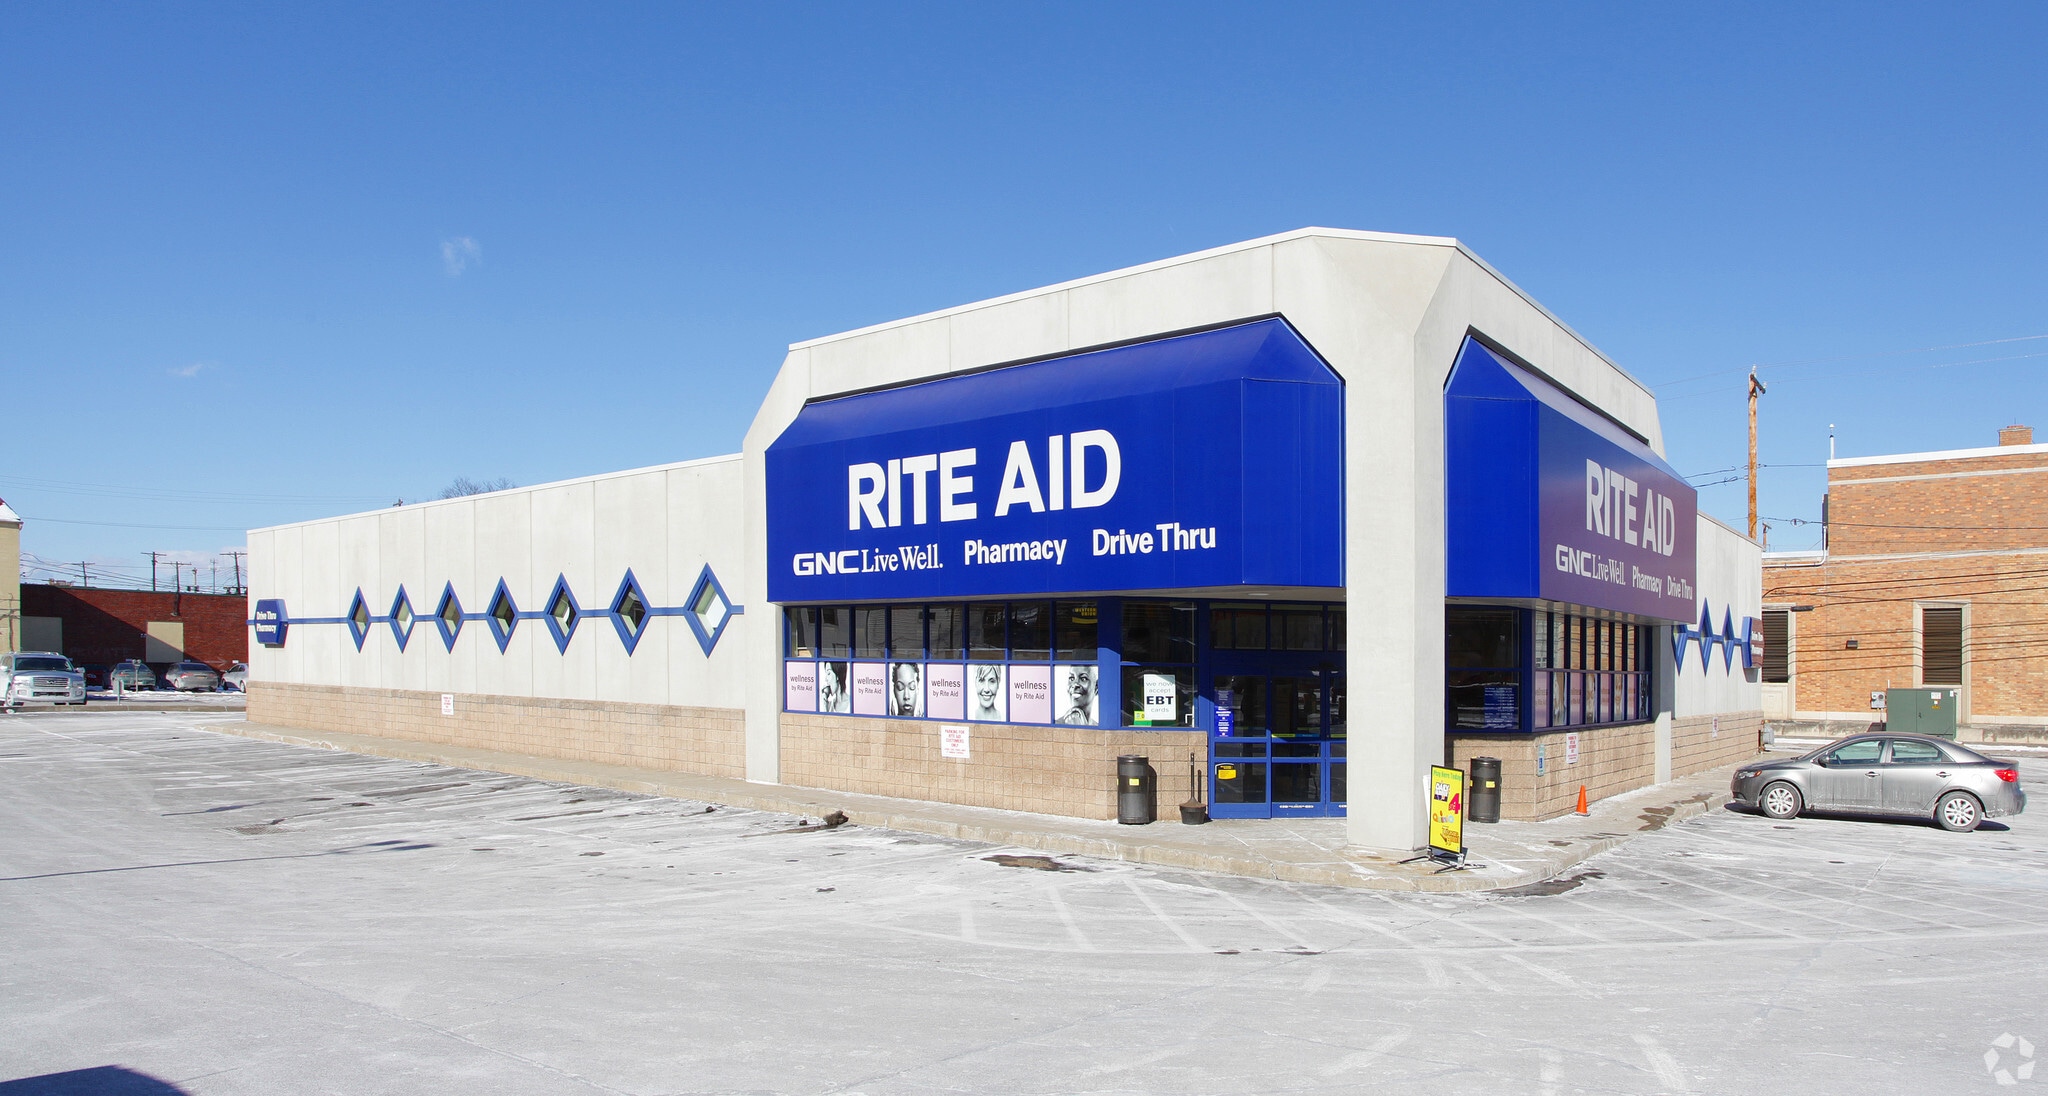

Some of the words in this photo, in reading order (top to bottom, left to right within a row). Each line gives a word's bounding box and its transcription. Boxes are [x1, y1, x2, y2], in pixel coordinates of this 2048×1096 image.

[848, 448, 977, 531] RITE
[995, 429, 1121, 517] AID
[1586, 458, 1638, 547] RITE
[1642, 487, 1675, 557] AID
[1092, 528, 1154, 557] Drive
[1156, 521, 1216, 552] Thru
[793, 549, 860, 576] GNC
[964, 538, 1068, 566] Pharmacy
[1556, 543, 1592, 578] GNC
[1632, 565, 1663, 599] Pharmacy
[1667, 574, 1681, 598] Drive
[1681, 578, 1693, 601] Thru
[790, 675, 814, 683] wellness
[857, 676, 884, 686] wellness
[931, 679, 961, 688] wellness
[1014, 680, 1048, 690] wellness
[939, 689, 949, 697] Rite
[1015, 692, 1022, 700] by
[1035, 692, 1045, 700] Aid
[1146, 695, 1174, 705] EBT
[1448, 793, 1461, 814] 4
